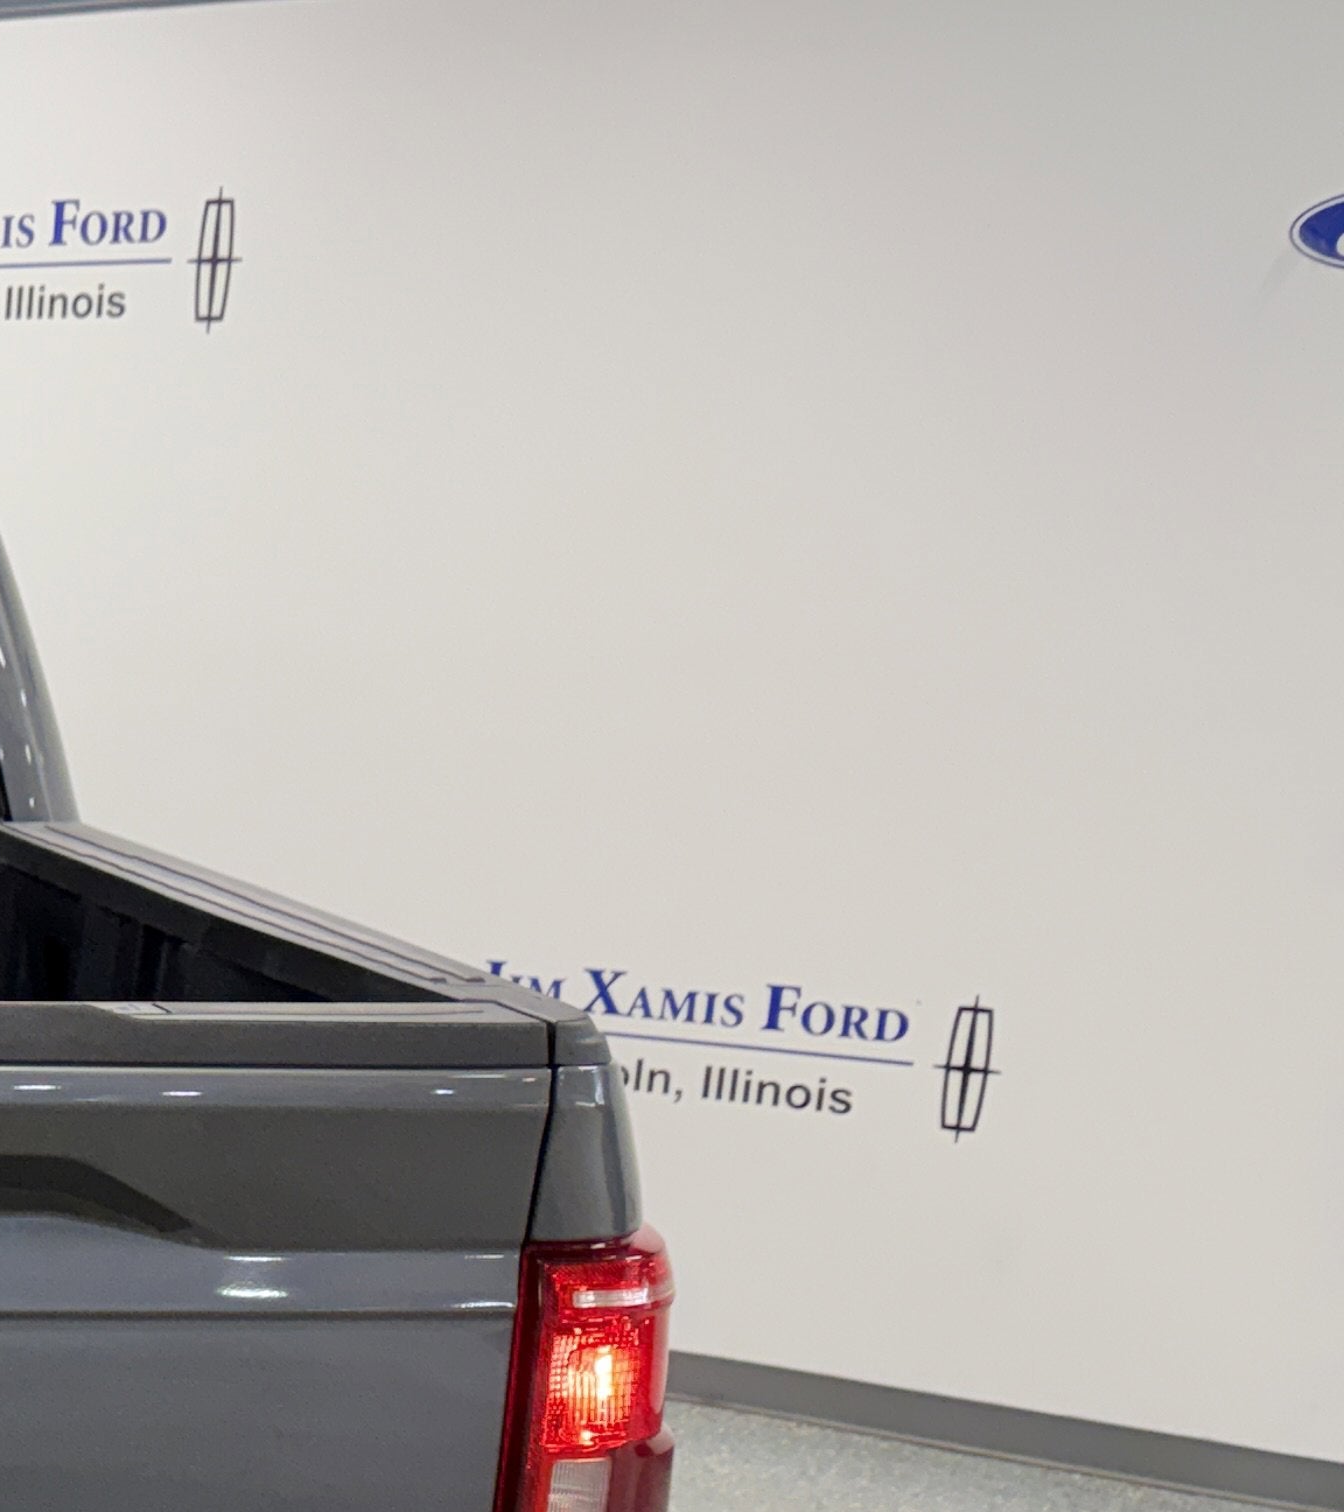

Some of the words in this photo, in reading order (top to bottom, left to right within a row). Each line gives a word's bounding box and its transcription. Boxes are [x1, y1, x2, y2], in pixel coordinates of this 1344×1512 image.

[49, 199, 168, 248] FORD
[4, 283, 127, 320] Illinois
[583, 967, 746, 1029] XAMIS
[761, 983, 910, 1044] FORD
[701, 1065, 854, 1115] Illinois
